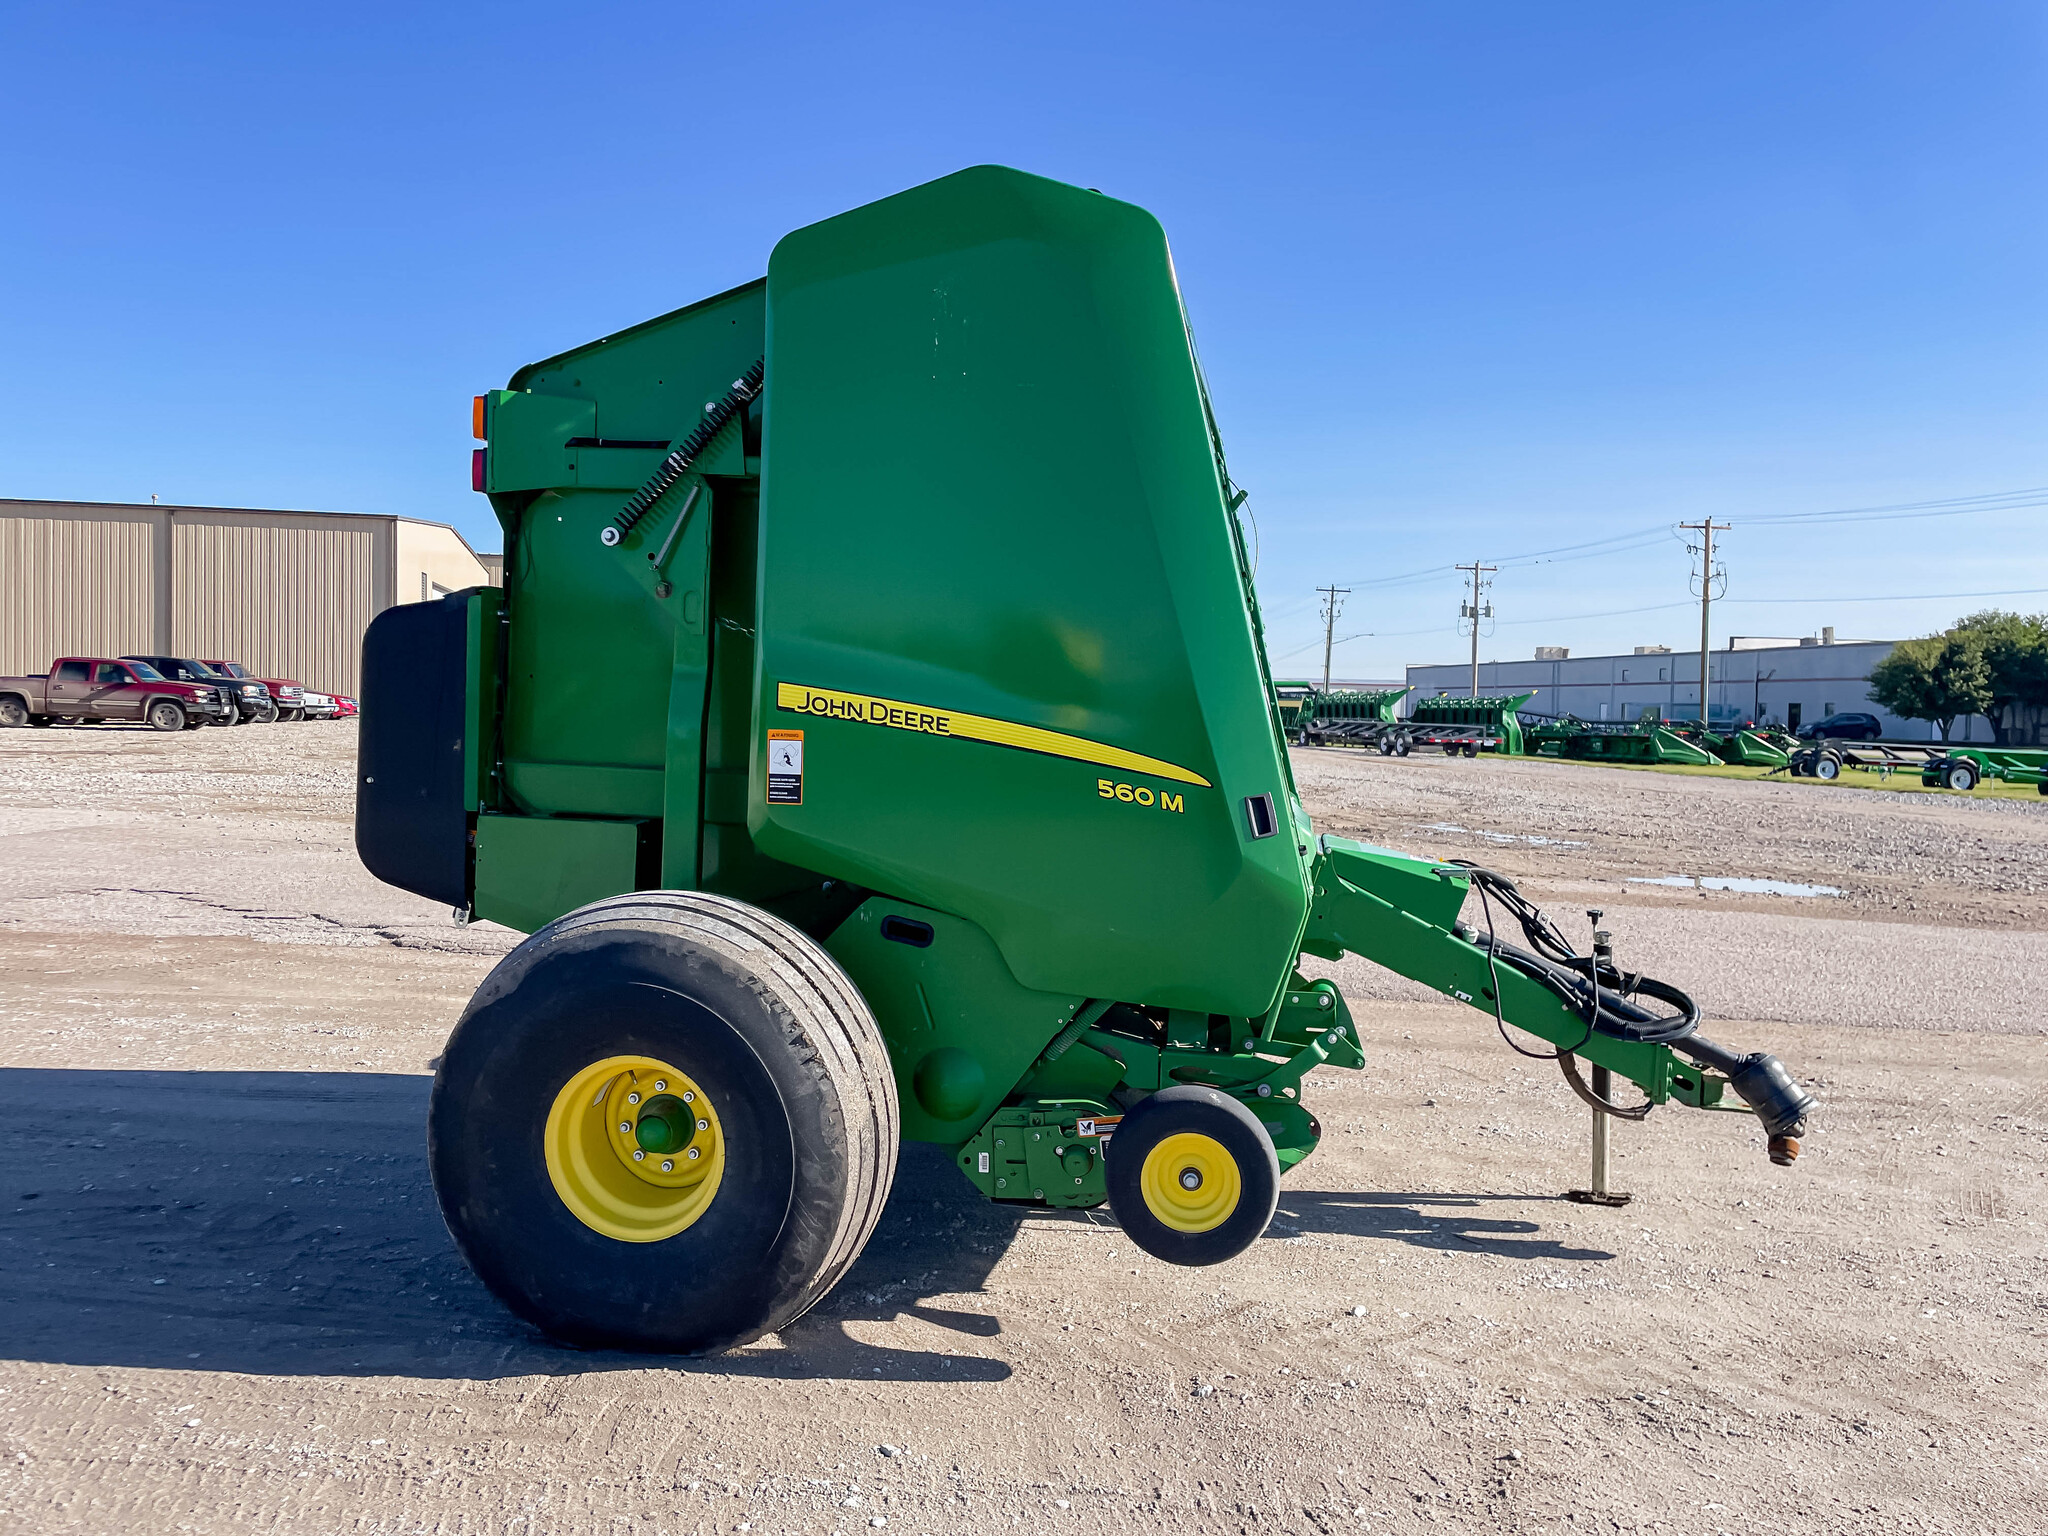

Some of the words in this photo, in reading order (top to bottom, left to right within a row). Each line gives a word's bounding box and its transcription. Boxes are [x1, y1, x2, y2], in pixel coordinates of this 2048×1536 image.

[797, 692, 862, 718] JOHN
[870, 702, 950, 733] DEERE
[1098, 779, 1155, 806] 560
[1160, 791, 1184, 813] M
